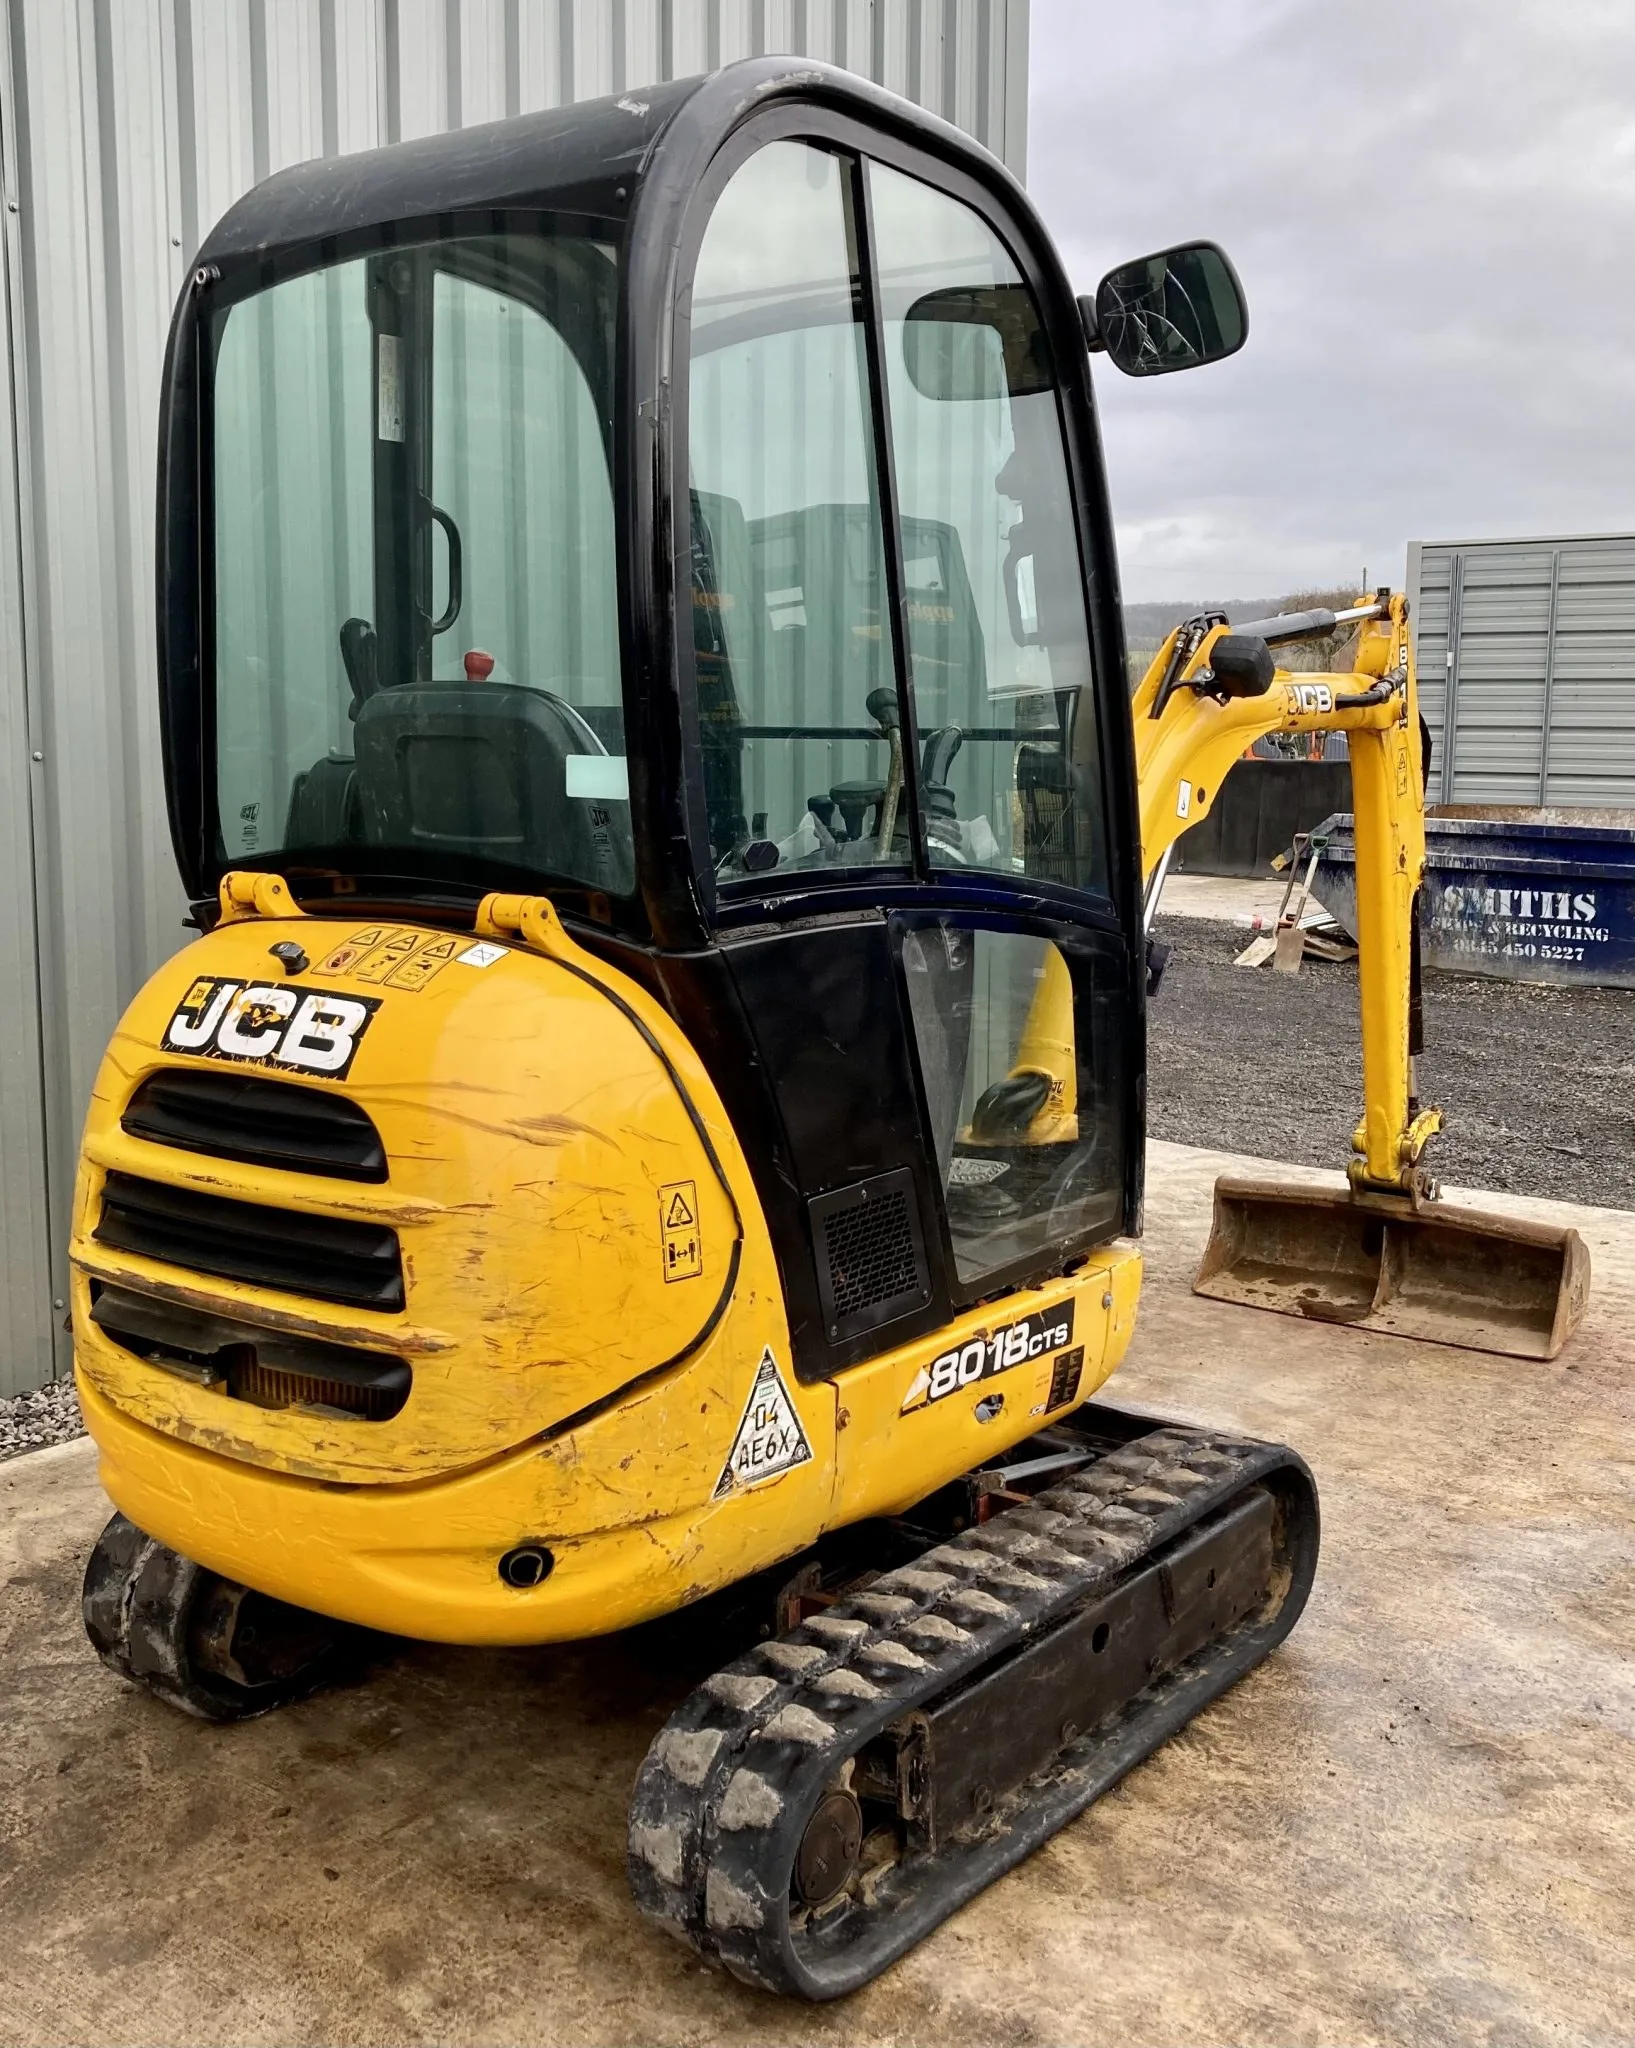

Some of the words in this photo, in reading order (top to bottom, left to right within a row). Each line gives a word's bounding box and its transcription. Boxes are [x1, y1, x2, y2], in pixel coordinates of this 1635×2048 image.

[1443, 885, 1597, 922] SMITHS
[1505, 921, 1609, 942] RECYCLING
[1502, 942, 1537, 959] 450
[1541, 944, 1585, 961] 5227
[168, 981, 367, 1071] JCB
[737, 1426, 790, 1472] AE6X
